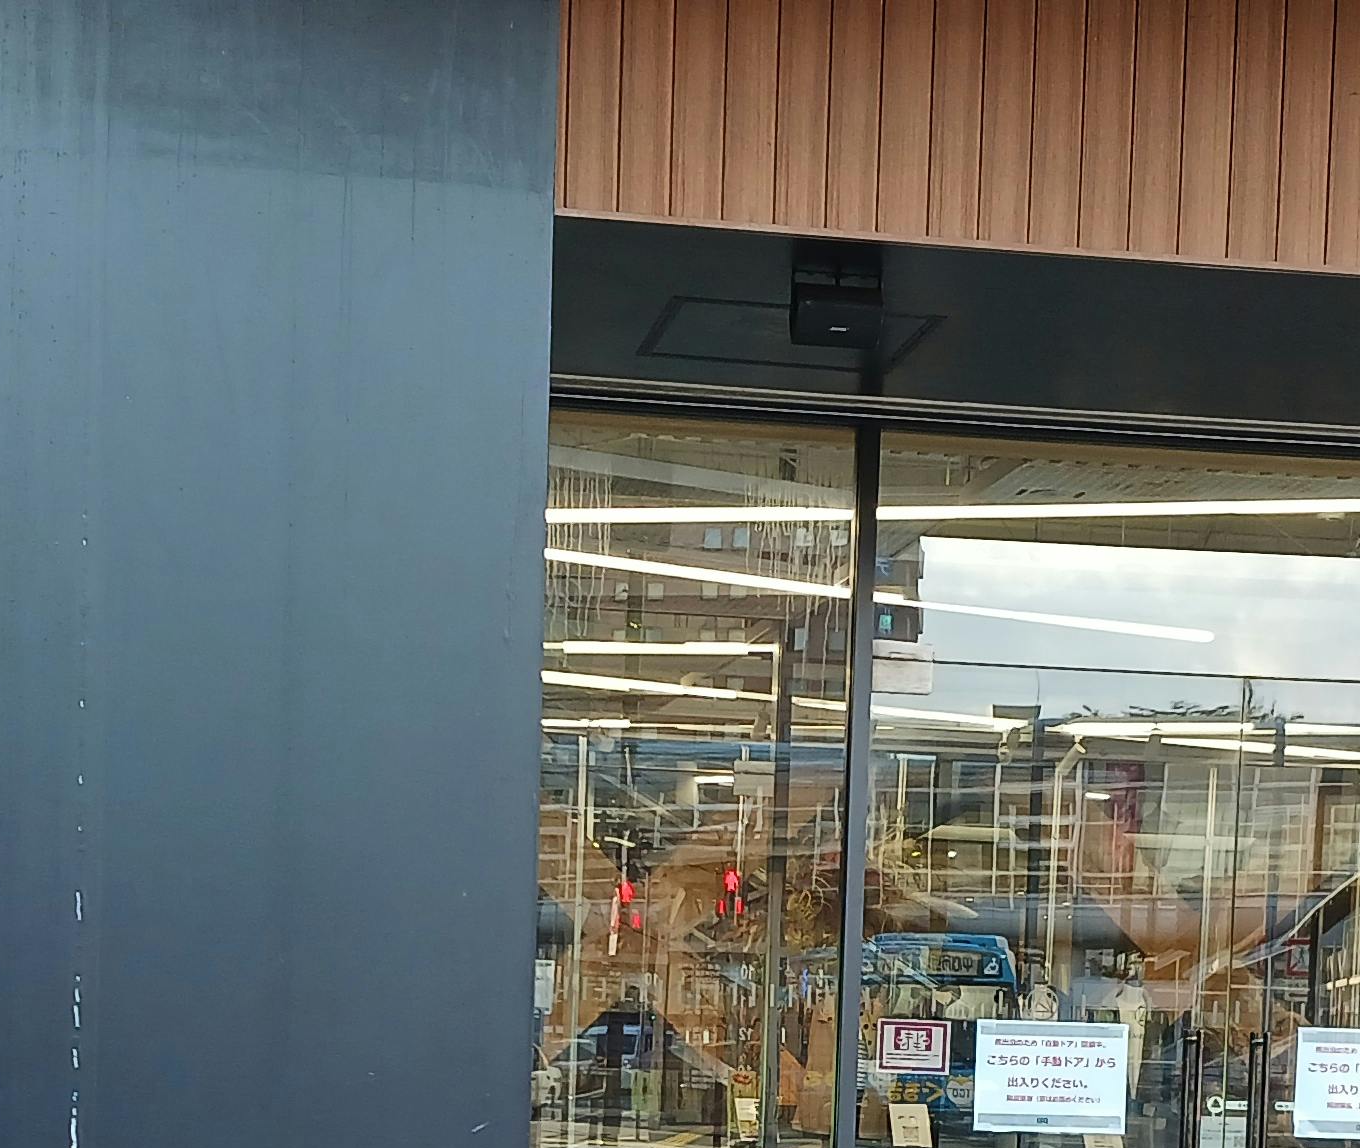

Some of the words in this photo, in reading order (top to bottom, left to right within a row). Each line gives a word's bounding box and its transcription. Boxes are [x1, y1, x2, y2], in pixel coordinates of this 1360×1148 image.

[986, 1055, 1116, 1068] こちらの「手動ドア」から
[1007, 1076, 1088, 1089] 出入りください。
